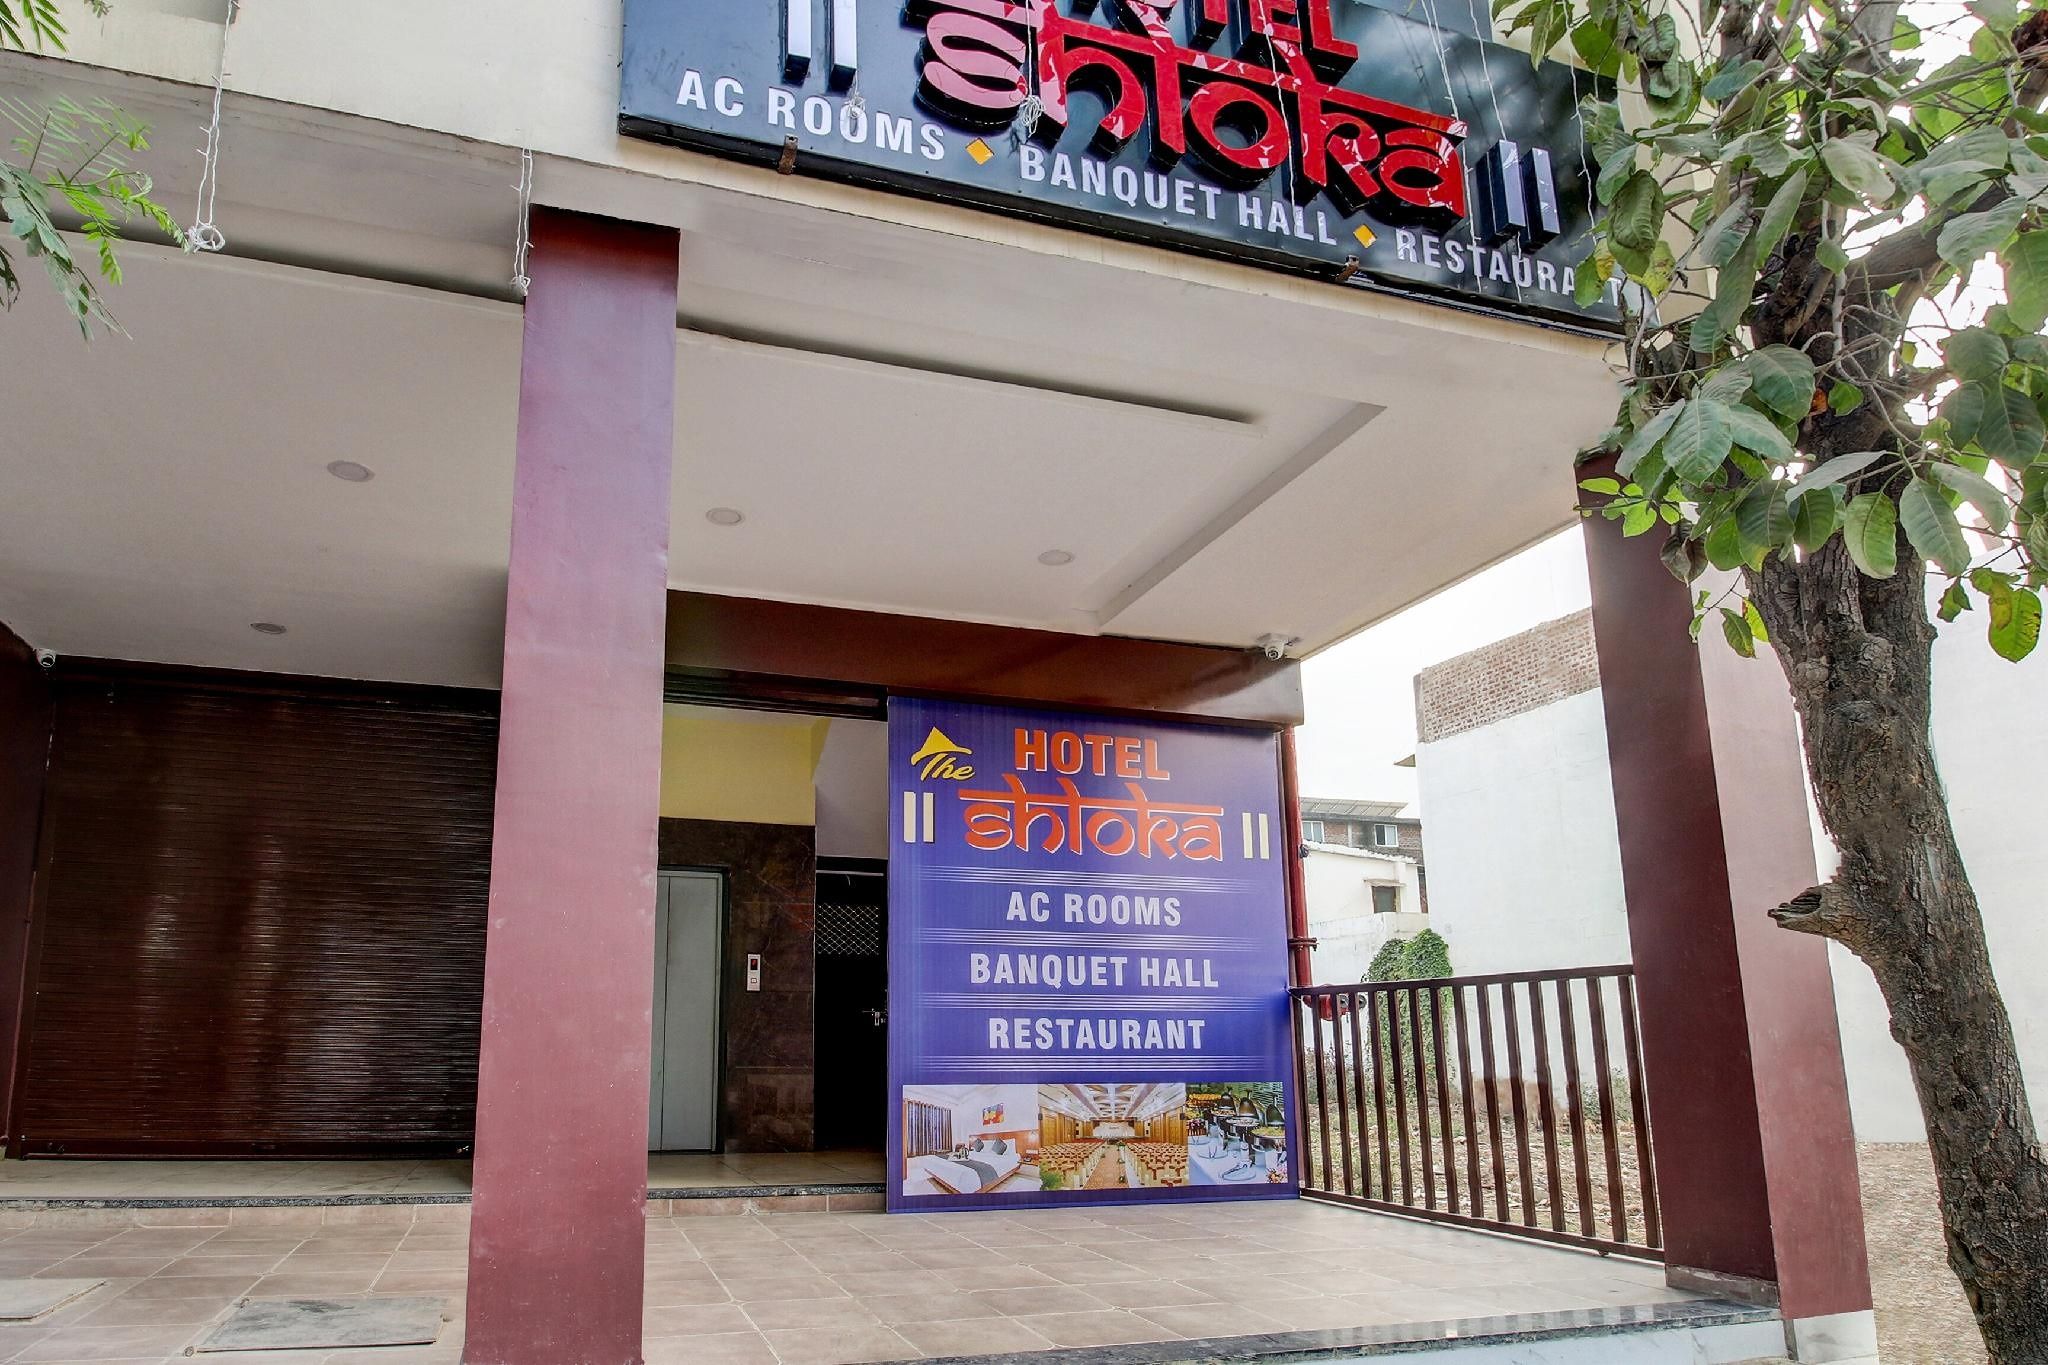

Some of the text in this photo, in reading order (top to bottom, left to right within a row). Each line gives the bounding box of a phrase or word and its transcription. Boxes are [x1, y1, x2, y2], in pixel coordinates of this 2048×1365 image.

[675, 68, 945, 162] AC ROOMS
[1019, 144, 1338, 247] BANQUET HALL
[1395, 228, 1622, 306] RESTAURAT
[919, 752, 977, 781] The
[1015, 728, 1170, 780] HOTEL
[1006, 891, 1182, 927] AC ROOMS
[969, 952, 1219, 989] BANQUET HALL
[988, 1017, 1206, 1050] RESTAURANT
